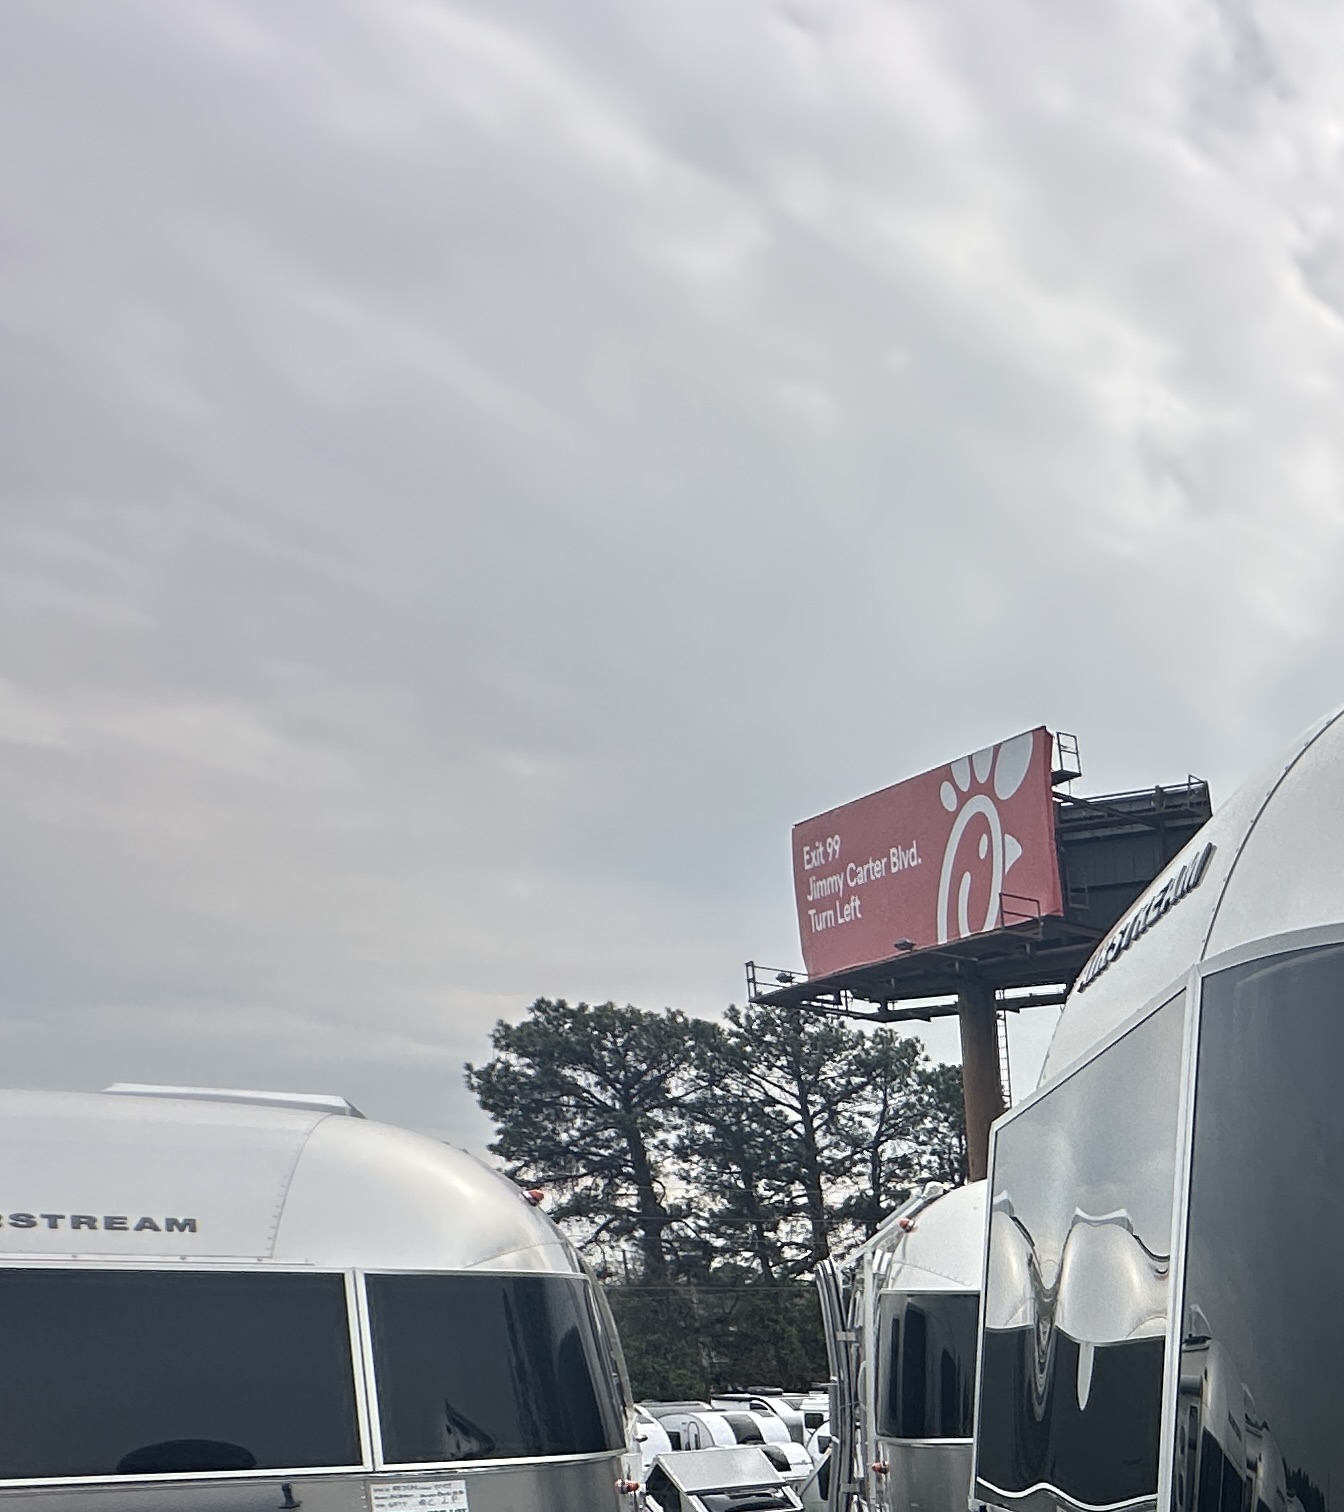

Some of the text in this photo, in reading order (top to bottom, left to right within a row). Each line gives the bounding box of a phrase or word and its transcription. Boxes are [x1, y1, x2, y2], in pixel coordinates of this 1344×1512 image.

[803, 834, 841, 870] Exit 99
[807, 840, 922, 901] Jimmy Carter Blvd.
[808, 895, 862, 933] Turn Left
[0, 1212, 197, 1233] STREAM
